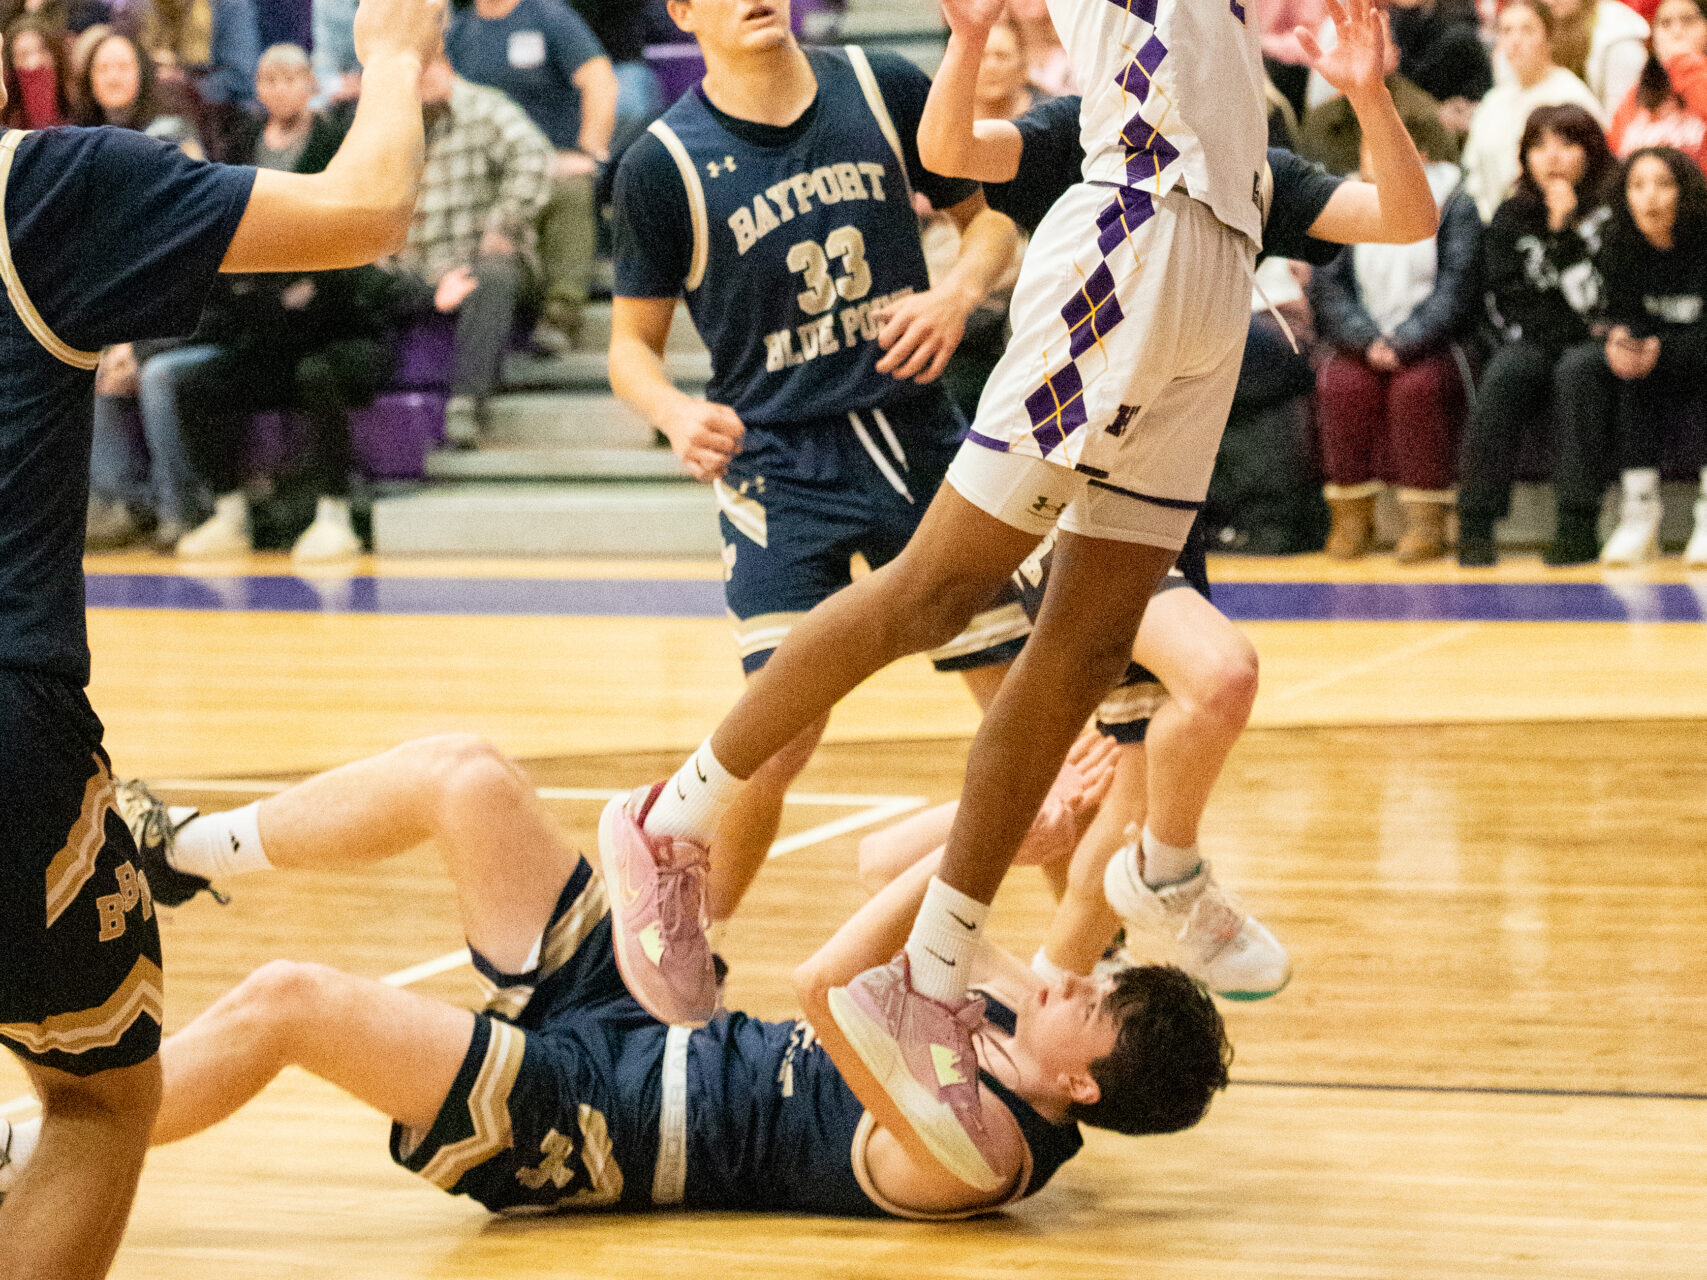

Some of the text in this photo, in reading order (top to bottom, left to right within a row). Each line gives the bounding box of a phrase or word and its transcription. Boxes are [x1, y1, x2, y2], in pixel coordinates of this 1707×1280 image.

[727, 161, 886, 256] BAYPORT
[785, 224, 873, 315] 33
[763, 312, 840, 373] BLUE
